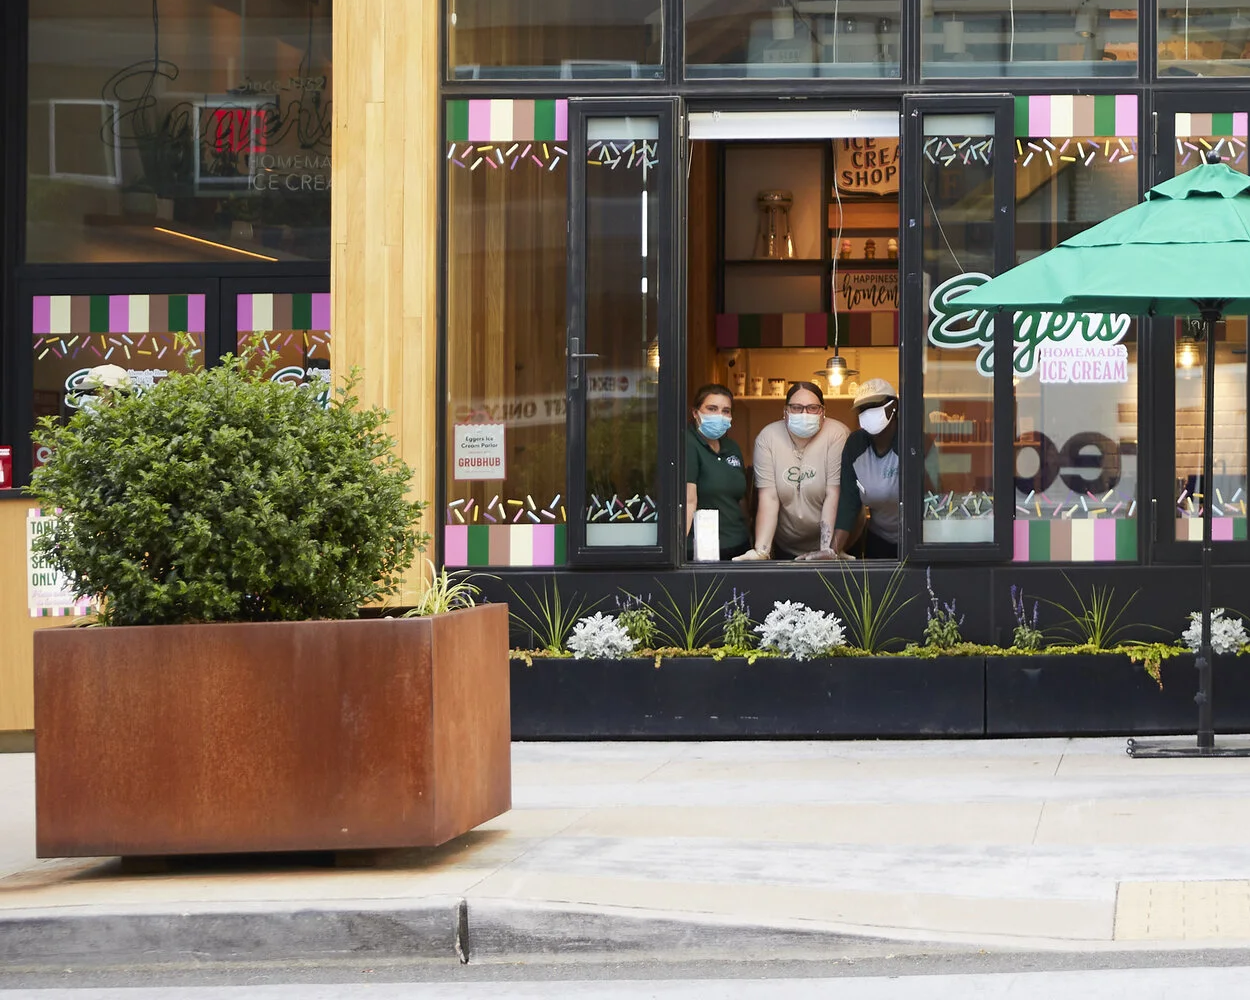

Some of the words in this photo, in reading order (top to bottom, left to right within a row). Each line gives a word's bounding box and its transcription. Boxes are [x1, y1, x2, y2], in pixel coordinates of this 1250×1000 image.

[248, 173, 281, 191] ICE
[842, 166, 897, 187] SHOP
[853, 274, 898, 283] HAPPINESS
[1043, 347, 1125, 358] HOMEMADE
[1042, 360, 1067, 381] ICE
[1072, 360, 1126, 380] CREAM
[465, 435, 484, 443] Eggers
[458, 457, 501, 468] GRUBHUB
[32, 572, 58, 587] ONLY
